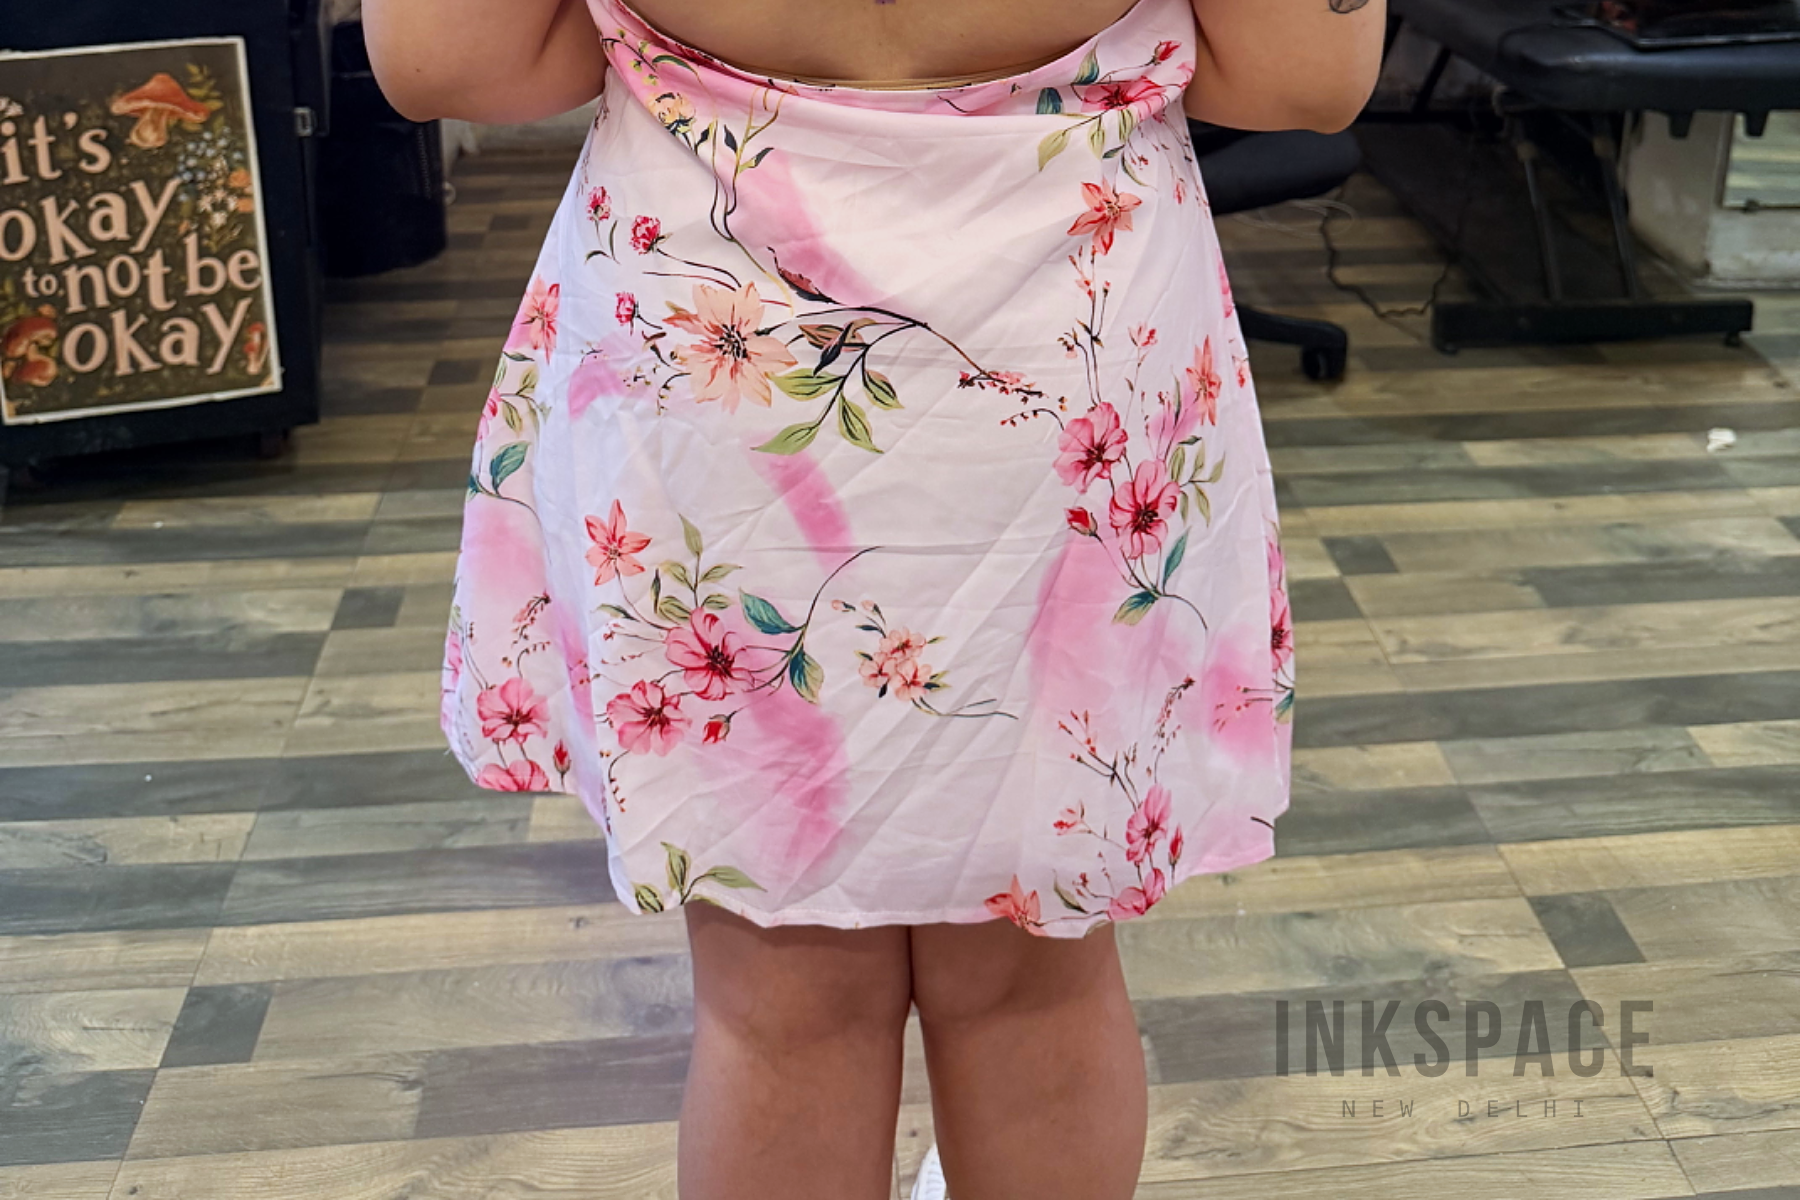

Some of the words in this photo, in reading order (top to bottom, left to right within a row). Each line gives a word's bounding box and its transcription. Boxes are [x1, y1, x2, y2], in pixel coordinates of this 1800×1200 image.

[1, 113, 111, 184] it's
[0, 179, 181, 263] okay
[23, 267, 58, 297] to
[63, 249, 176, 312] not
[184, 233, 261, 296] be
[62, 297, 252, 375] okay
